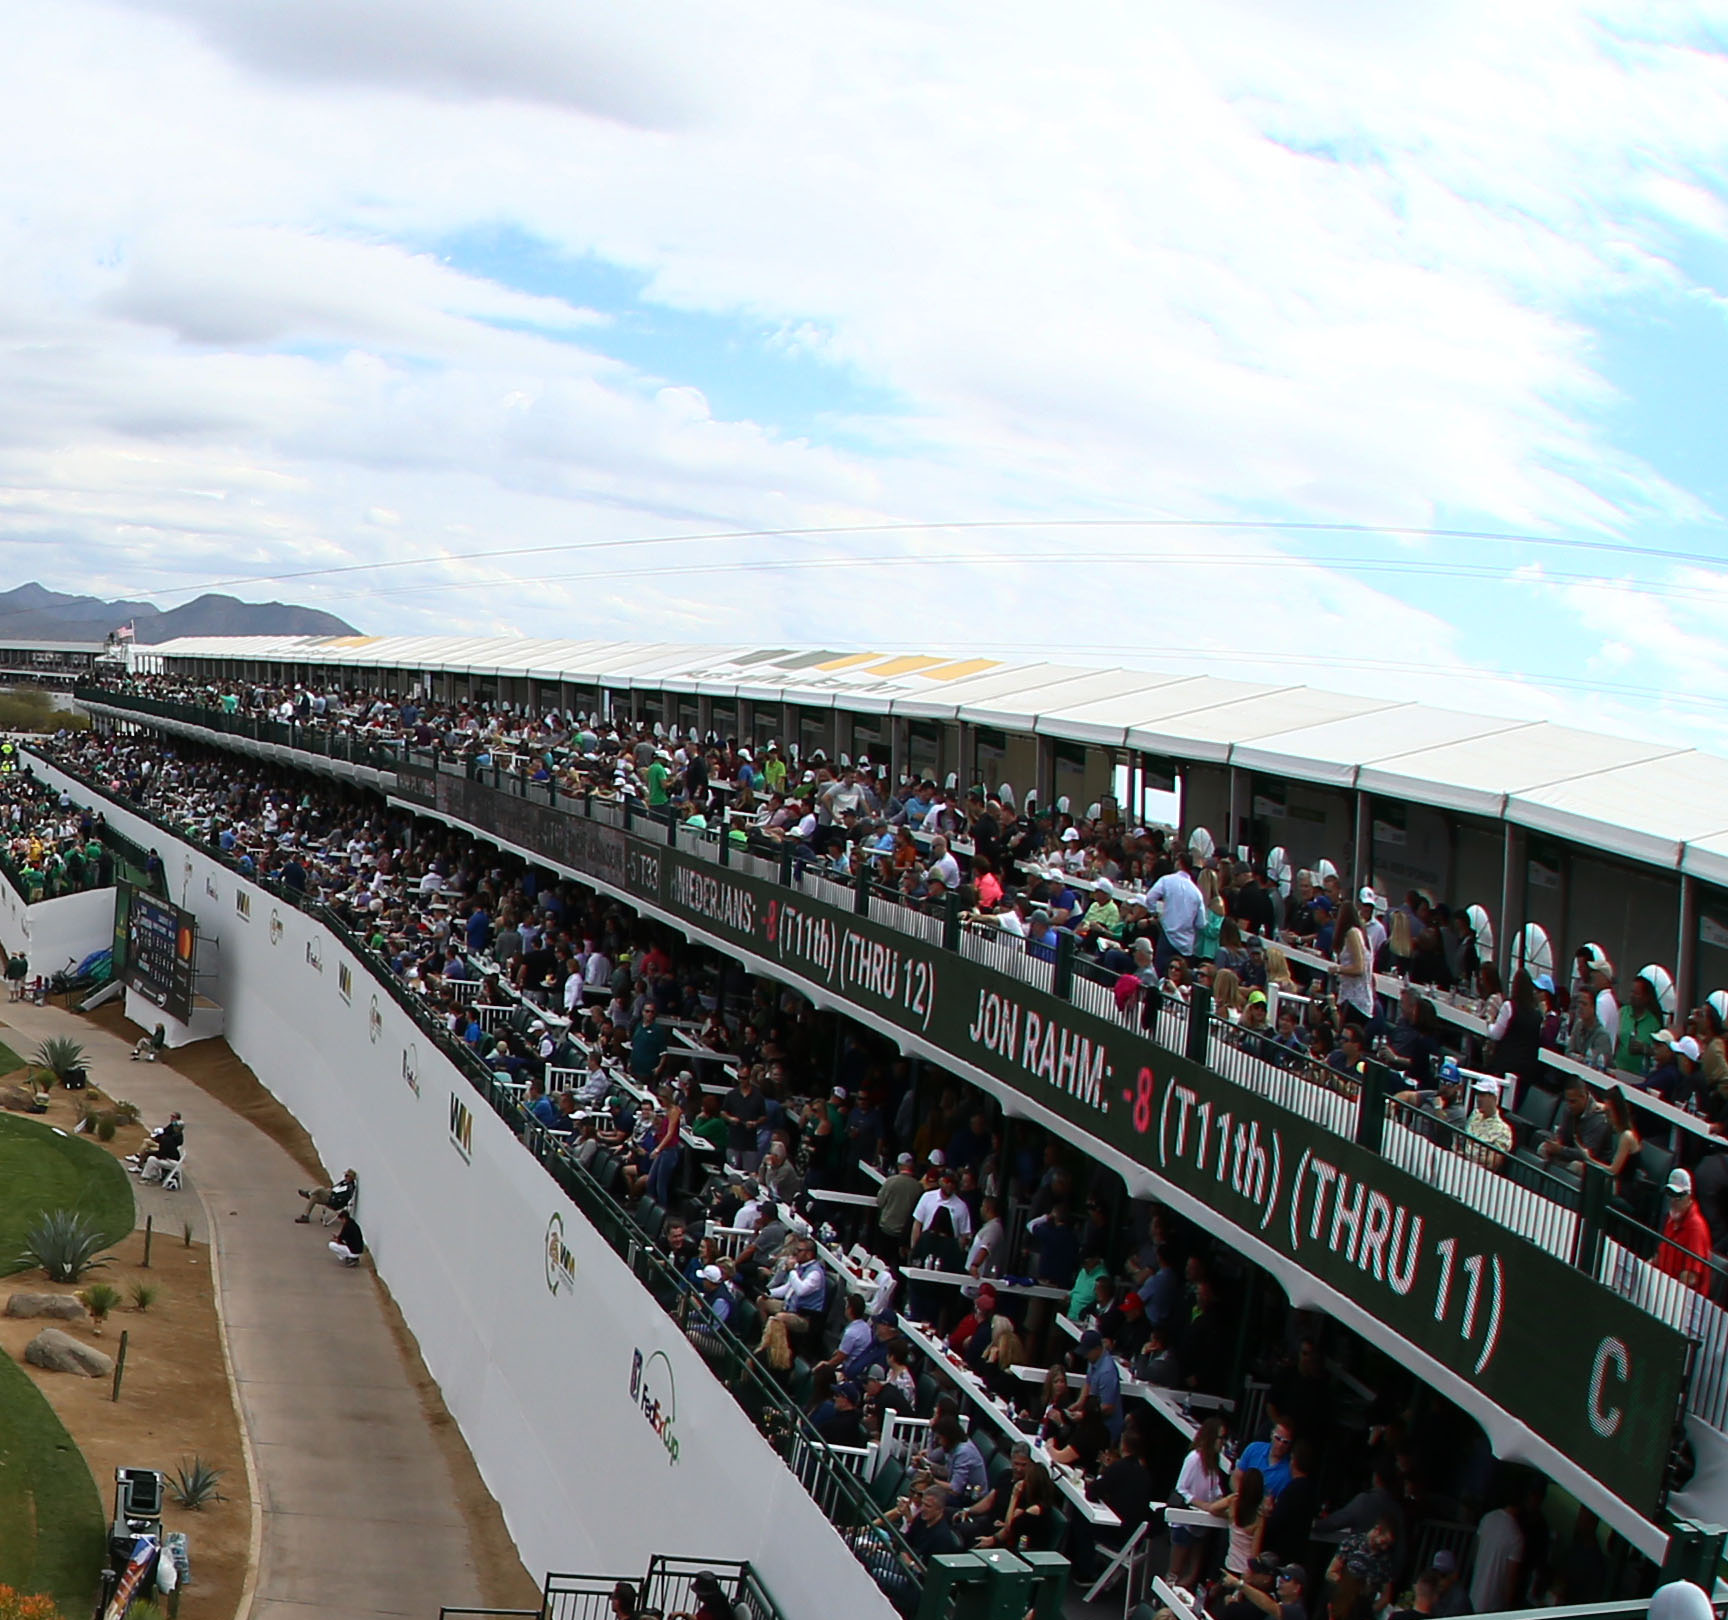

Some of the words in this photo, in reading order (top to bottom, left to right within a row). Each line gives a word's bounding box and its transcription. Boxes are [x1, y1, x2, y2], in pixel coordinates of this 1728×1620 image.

[640, 854, 659, 892] T33
[761, 899, 777, 942] -8
[779, 903, 836, 984] (T11th)
[840, 927, 899, 1000] (THRU
[903, 957, 934, 1032] 12)
[449, 1090, 473, 1156] WM
[969, 987, 1019, 1062] JON
[1021, 1009, 1114, 1114] RAHM:
[1122, 1066, 1155, 1134] -8
[1158, 1075, 1282, 1231] (T11th)
[1290, 1146, 1426, 1296] (THRU
[1434, 1237, 1506, 1376] 11)
[641, 1383, 680, 1467] FedExCup
[1586, 1335, 1633, 1439] C
